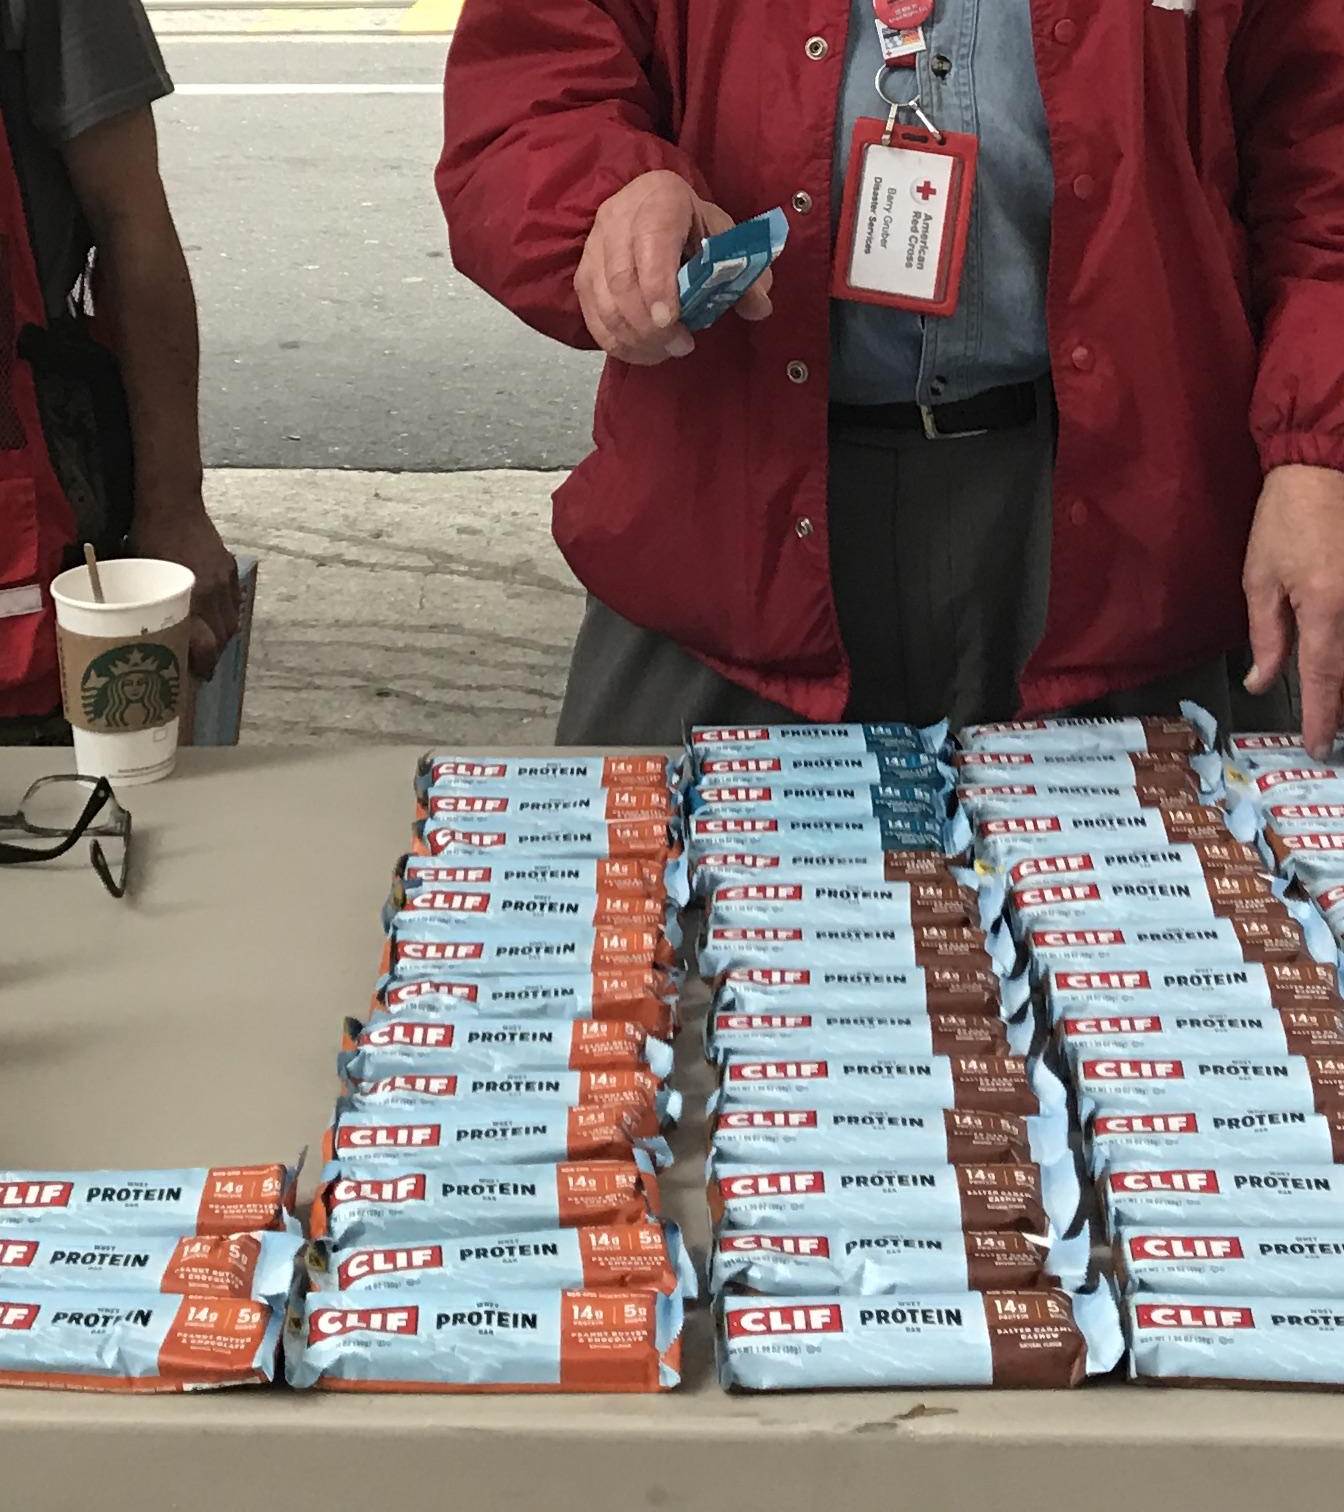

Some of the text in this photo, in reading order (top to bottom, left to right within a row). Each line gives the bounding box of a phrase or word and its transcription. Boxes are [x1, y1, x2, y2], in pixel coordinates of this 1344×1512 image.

[864, 176, 883, 255] Disaster Services
[880, 187, 896, 249] Barry Gruber
[905, 210, 922, 269] Red Cross
[916, 212, 933, 270] American
[438, 764, 586, 777] CLIF PROTEIN
[704, 759, 862, 772] CLIF PROTEIN
[701, 789, 854, 801] CLIF PROTEIN
[413, 894, 578, 912] CLIF PROTEIN
[1023, 886, 1190, 903] CLIF PROTEIN
[1068, 972, 1246, 988] CLIF PROTEIN
[371, 1026, 552, 1045] CLIF PROTEIN
[741, 1064, 930, 1079] CLIF PROTEIN
[1095, 1061, 1287, 1079] CLIF PROTEIN
[1106, 1113, 1304, 1132] CLIF PROTEIN
[350, 1126, 546, 1145] CLIF PROTEIN
[731, 1175, 934, 1194] CLIF PROTEIN
[965, 1168, 996, 1182] 14g
[1123, 1172, 1329, 1191] CLIF PROTEIN
[86, 1187, 181, 1204] PROTEIN
[213, 1181, 246, 1197] 14g
[335, 1178, 535, 1202] CLIF PROTEIN
[588, 1233, 620, 1249] 14g
[732, 1237, 941, 1256] CLIF PROTEIN
[1143, 1239, 1234, 1257] CLIF
[50, 1249, 149, 1268] PROTEIN
[348, 1244, 557, 1278] CLIF PROTEIN
[187, 1306, 219, 1325] 14g
[572, 1305, 604, 1321] 14g
[993, 1299, 1027, 1314] 14g
[53, 1308, 152, 1329] PROTEIN
[317, 1309, 536, 1334] CLIF PROTEIN
[741, 1309, 961, 1331] CLIF PROTEIN
[1151, 1308, 1243, 1326] CLIF
